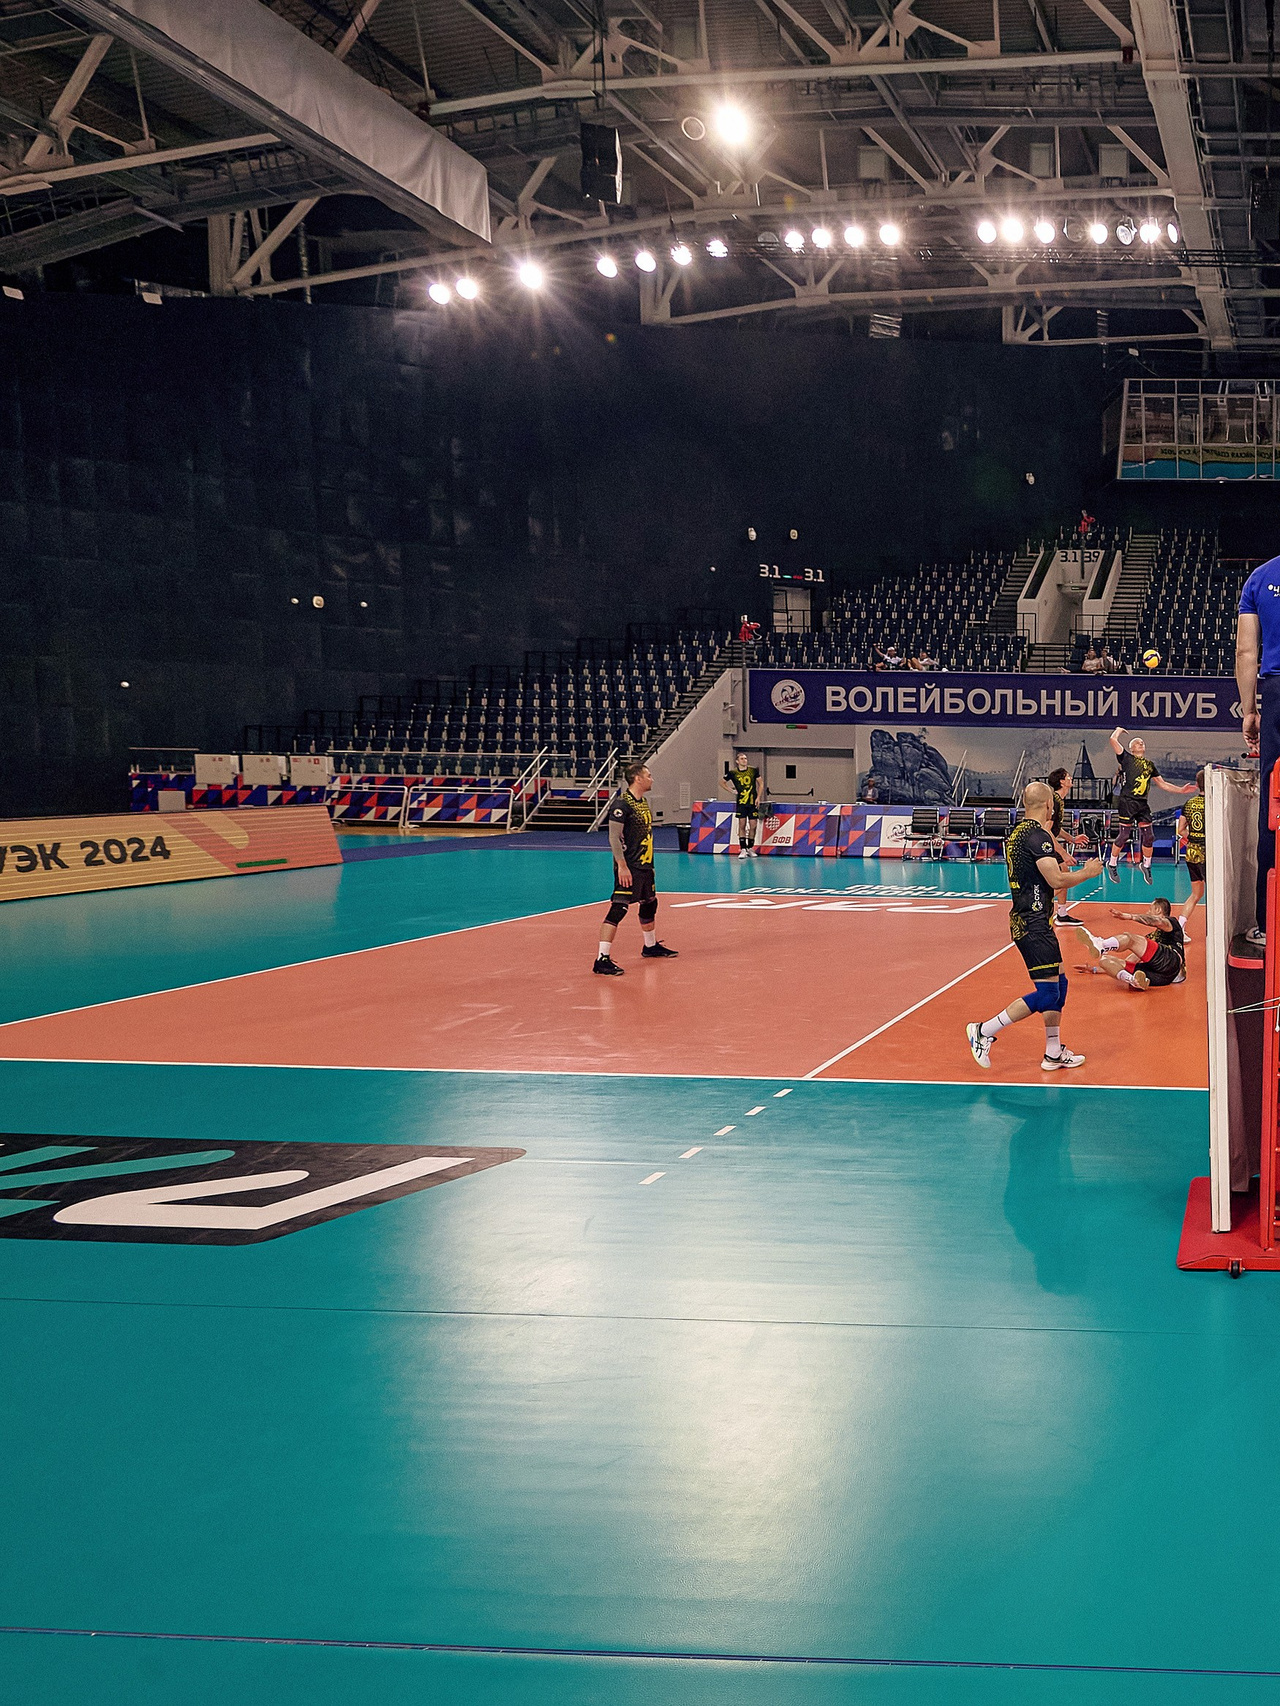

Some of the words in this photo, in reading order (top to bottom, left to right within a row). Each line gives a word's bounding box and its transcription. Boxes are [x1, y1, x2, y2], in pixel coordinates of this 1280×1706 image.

[1060, 550, 1079, 563] 3.1
[759, 563, 781, 579] 3.1
[804, 568, 825, 583] 3.1
[825, 682, 1118, 717] ВОЛЕЙБОЛЬНЫЙ
[1131, 690, 1218, 719] КЛУБ
[1191, 812, 1203, 831] 8
[79, 835, 171, 867] 2024
